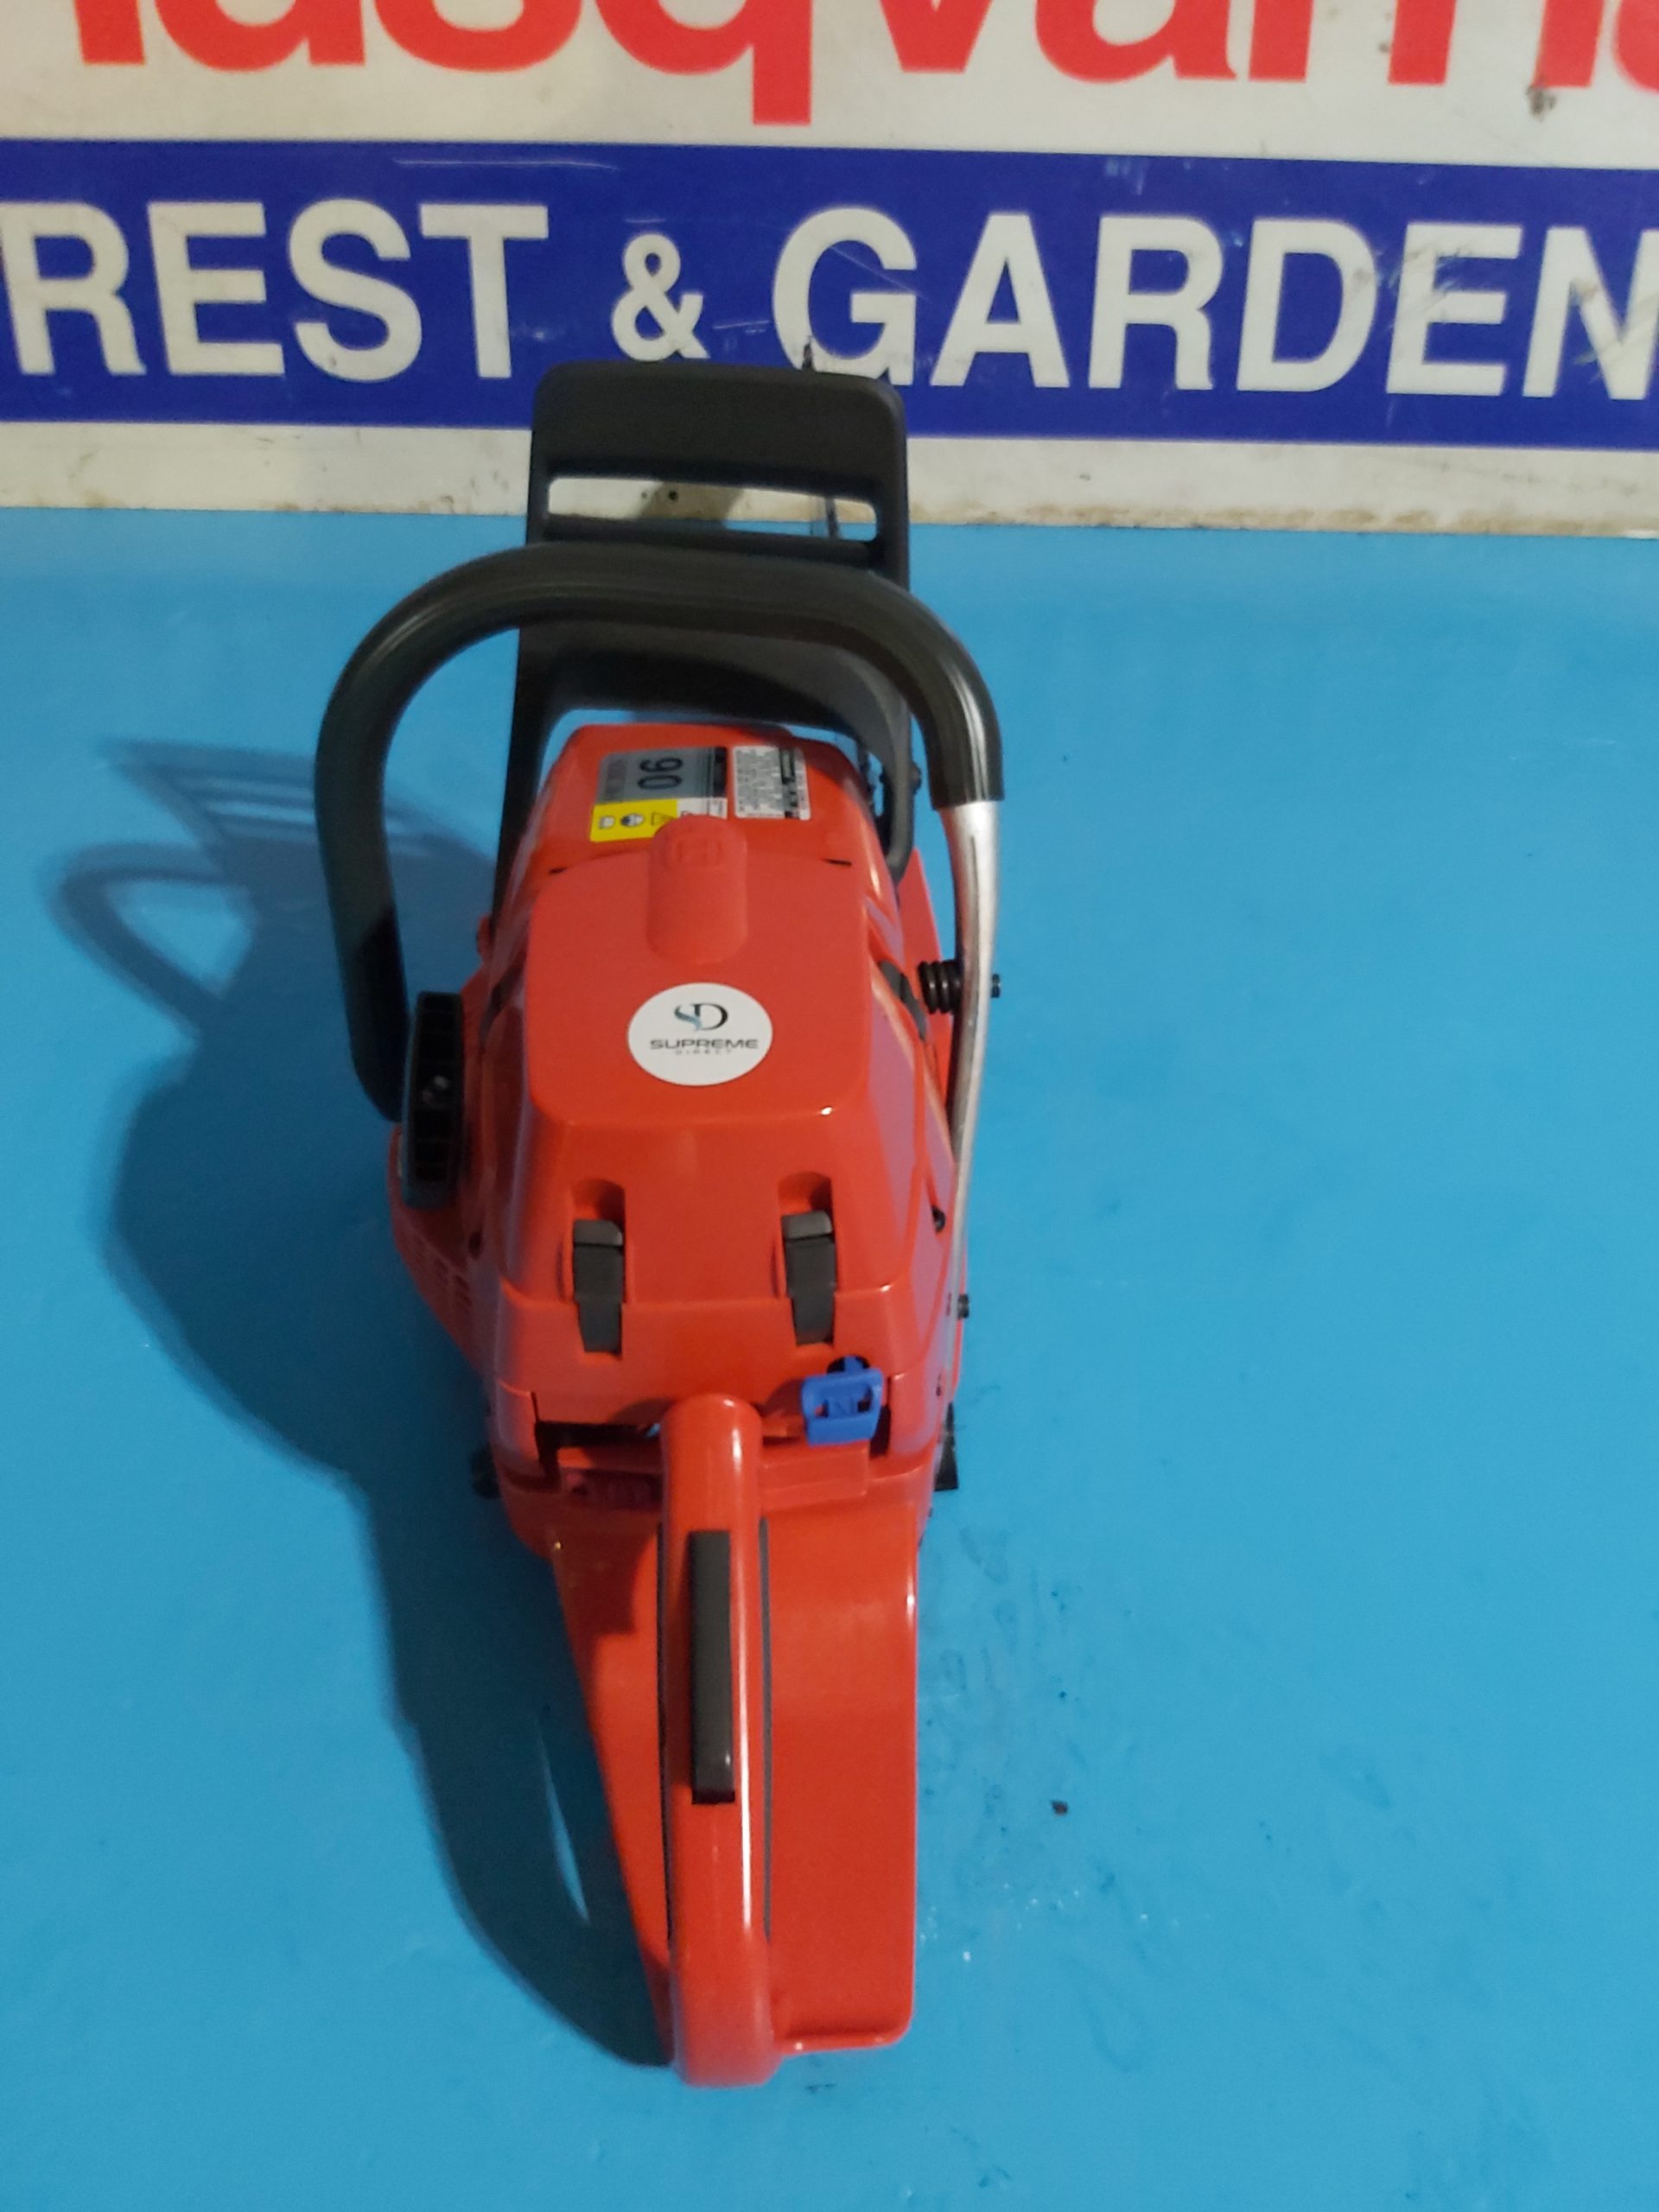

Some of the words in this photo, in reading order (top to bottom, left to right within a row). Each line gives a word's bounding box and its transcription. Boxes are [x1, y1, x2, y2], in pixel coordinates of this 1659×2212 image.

[0, 199, 550, 383] REST
[611, 232, 710, 362] &
[772, 204, 1659, 400] GARDEN
[650, 1039, 759, 1050] SUPREME
